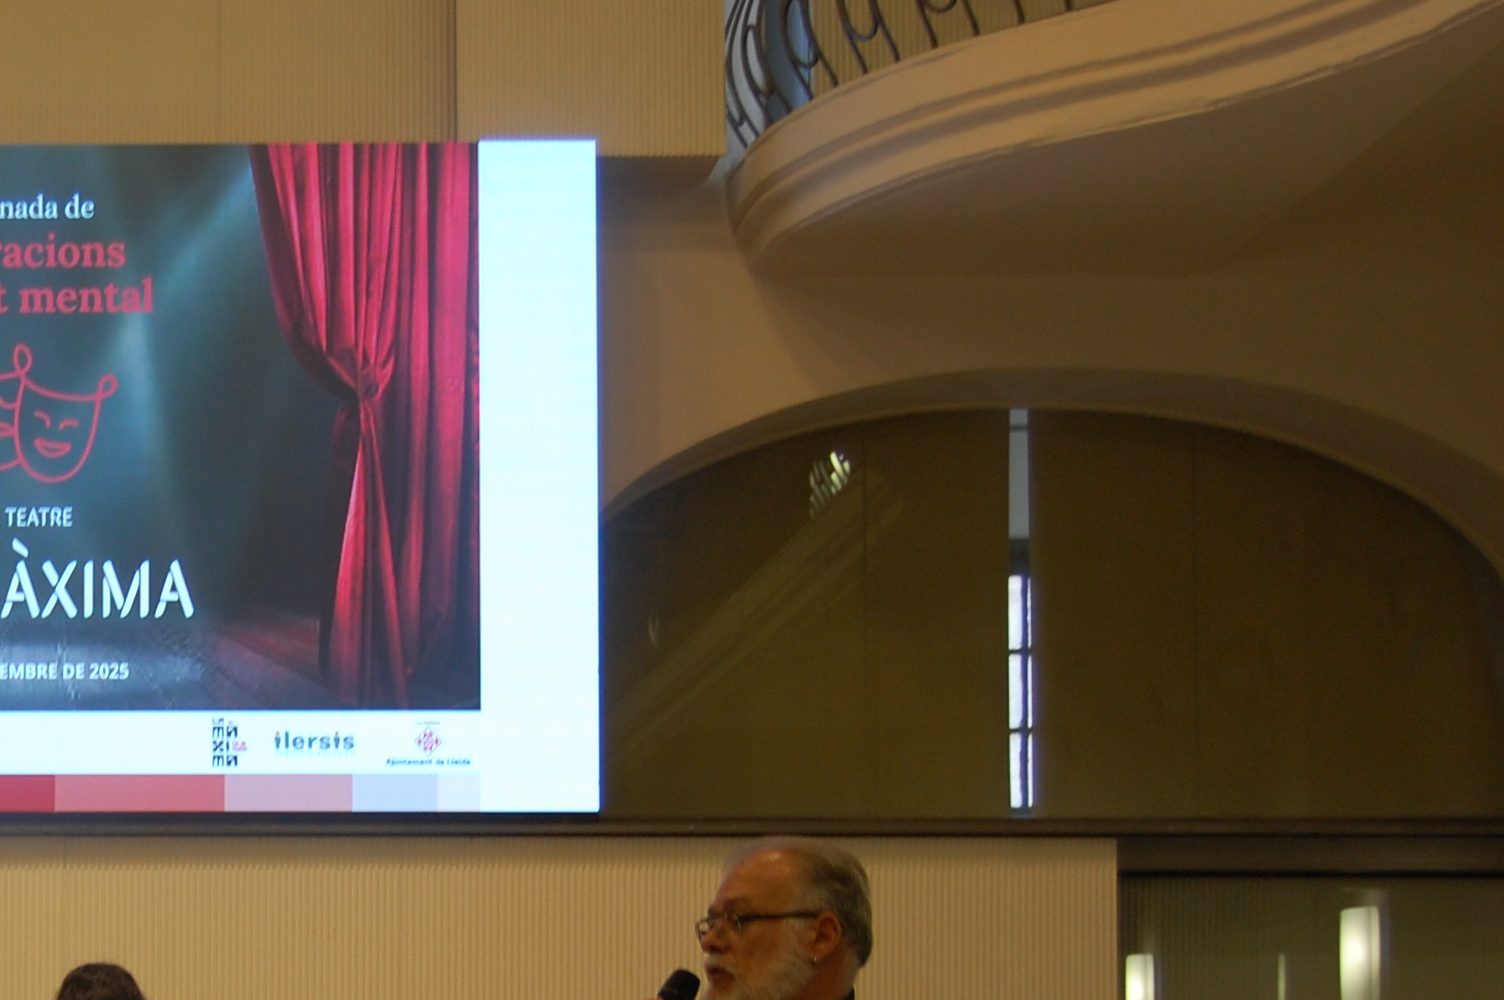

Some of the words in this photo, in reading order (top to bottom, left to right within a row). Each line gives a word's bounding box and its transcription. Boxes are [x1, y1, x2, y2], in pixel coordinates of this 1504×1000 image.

[65, 193, 95, 220] de
[19, 278, 154, 314] mental
[5, 506, 73, 528] TEATRE
[62, 662, 85, 681] DE
[90, 662, 130, 681] 2025
